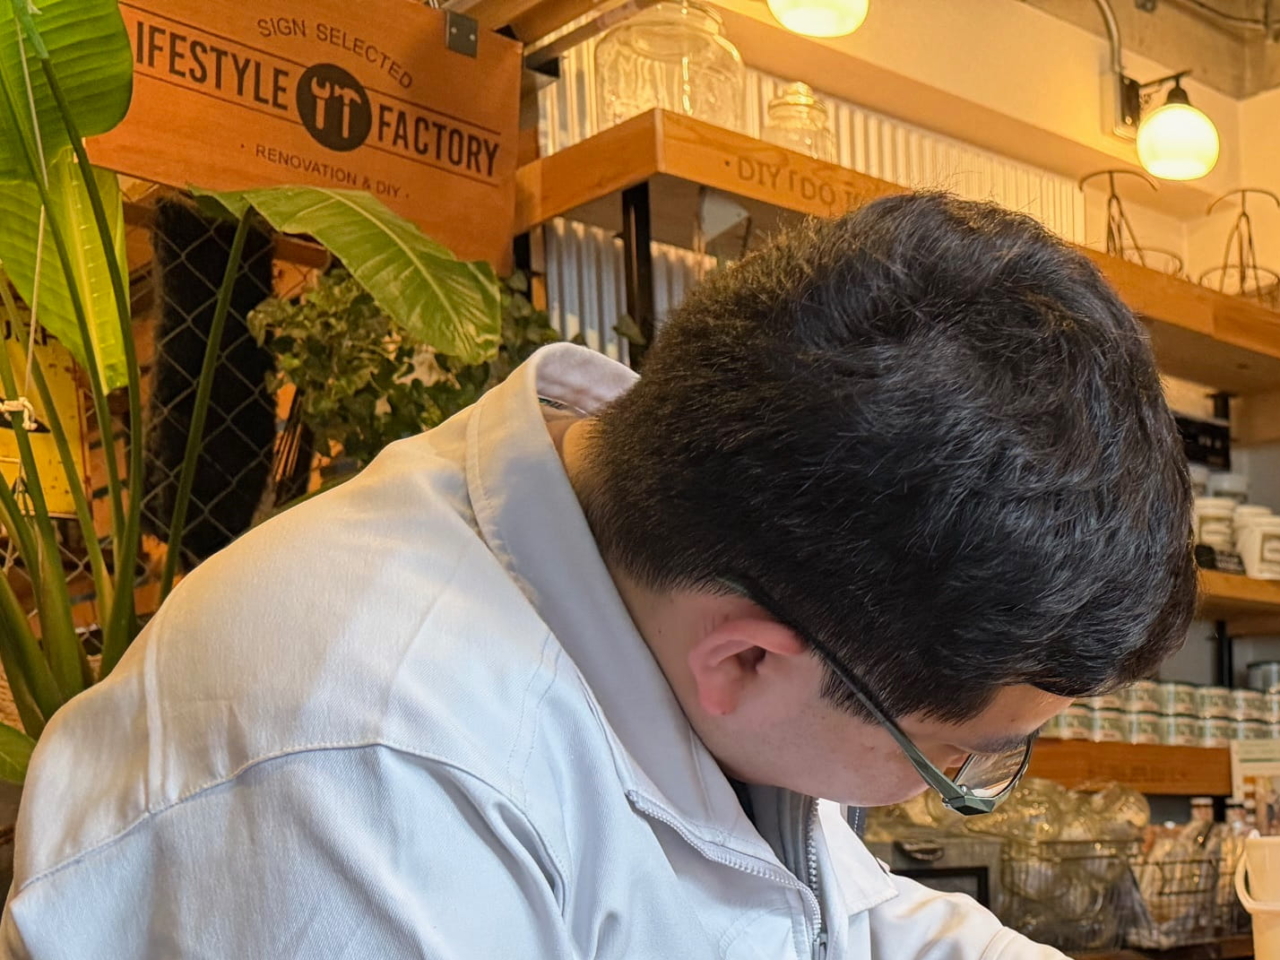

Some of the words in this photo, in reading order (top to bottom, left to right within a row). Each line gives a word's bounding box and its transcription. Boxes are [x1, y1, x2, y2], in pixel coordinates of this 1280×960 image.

[257, 17, 307, 38] SIGN
[316, 23, 413, 89] SELECTED
[255, 144, 357, 187] RENOVATION
[361, 177, 372, 190] &
[376, 180, 402, 199] DIY
[377, 103, 499, 177] FACTORY
[737, 156, 781, 189] DIY
